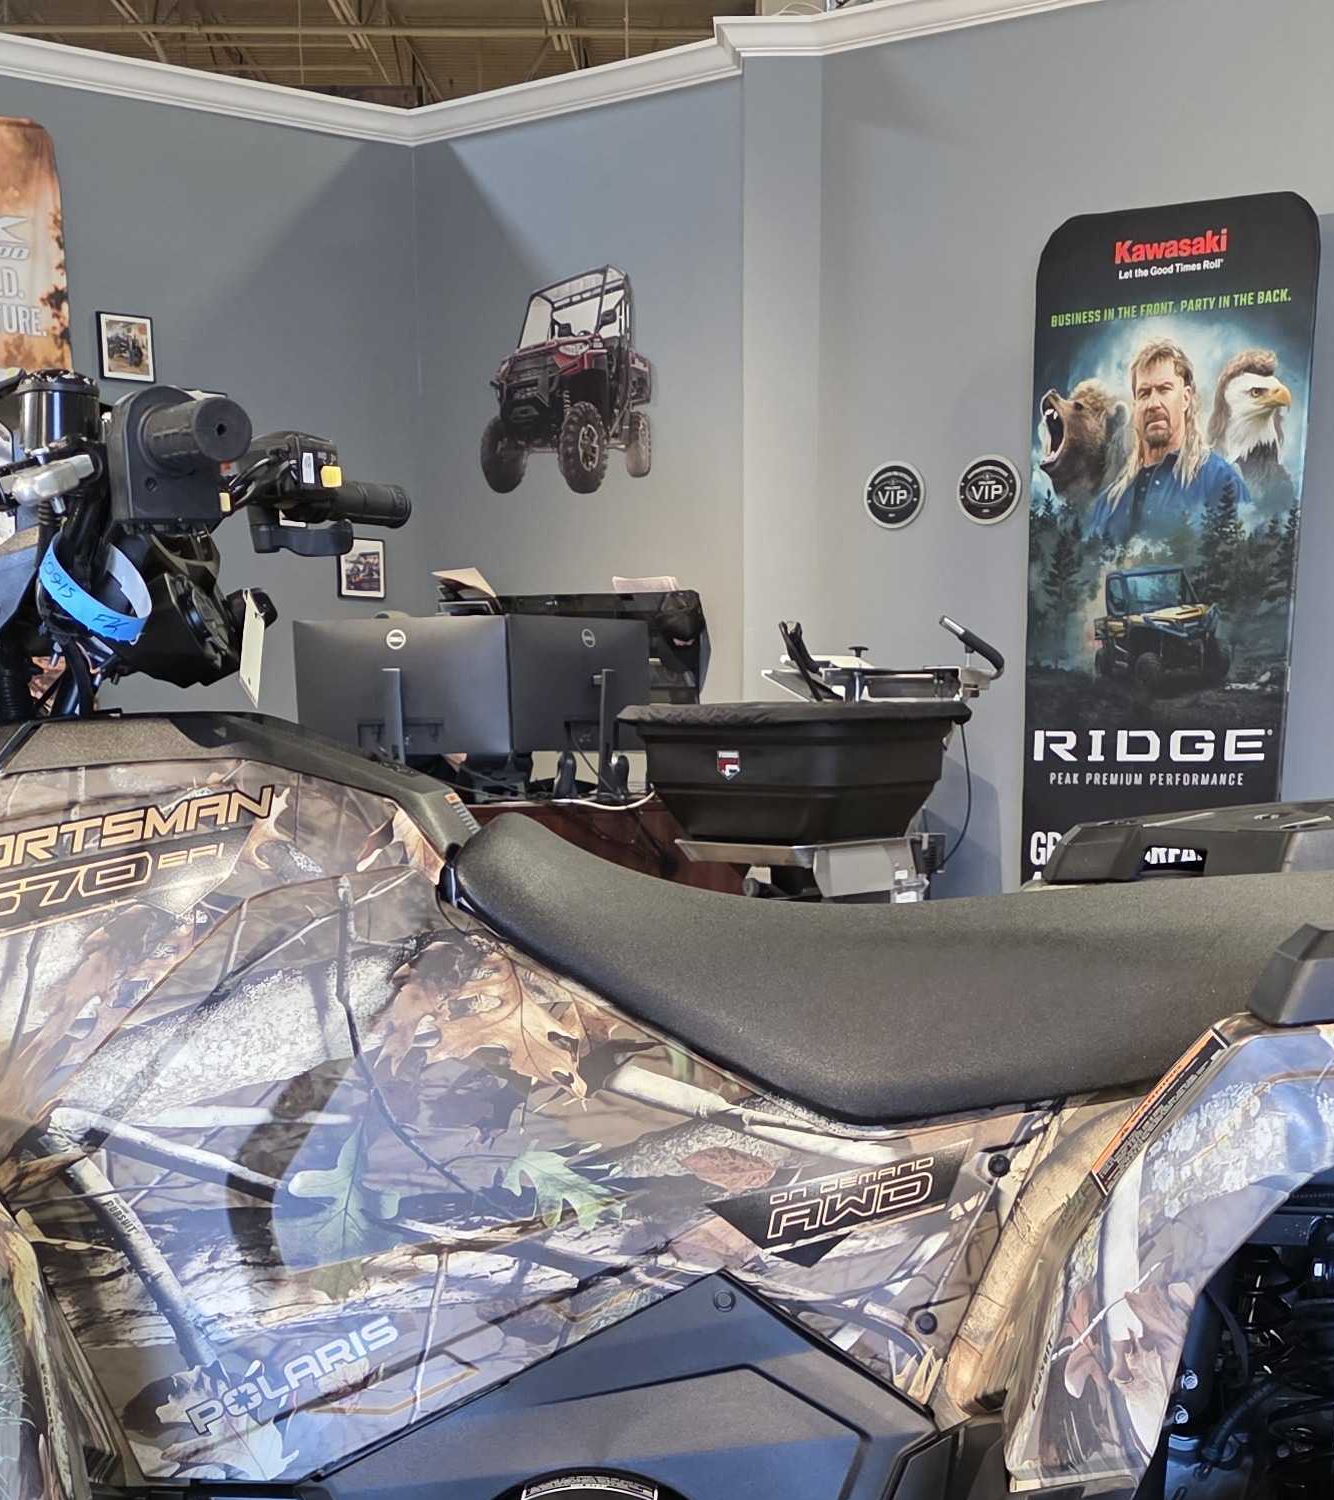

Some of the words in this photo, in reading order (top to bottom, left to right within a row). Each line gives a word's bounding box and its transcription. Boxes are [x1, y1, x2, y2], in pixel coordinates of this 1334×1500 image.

[1115, 228, 1228, 265] Kawasaki
[1118, 269, 1133, 280] Let
[1134, 267, 1149, 278] the
[1150, 264, 1174, 277] Good
[1175, 261, 1202, 274] Times
[1050, 310, 1101, 328] BUSINESS
[1103, 307, 1115, 320] IN
[1117, 304, 1138, 319] THE
[1139, 301, 1177, 317] FRONT.
[1180, 297, 1216, 312] PARTY
[1219, 296, 1231, 308] IN
[1233, 292, 1255, 306] THE
[1257, 287, 1292, 304] BACK.
[877, 489, 908, 505] VIP
[971, 484, 1003, 501] VIP
[1033, 728, 1266, 762] RIDGE
[1049, 771, 1080, 786] PEAK
[1085, 771, 1144, 786] PREMIUM
[1149, 771, 1245, 786] PERFORMANCE
[157, 842, 227, 870] EFI
[769, 1186, 807, 1205] ON
[820, 1156, 935, 1194] DEMAND
[103, 1199, 138, 1235] PURSUIT
[767, 1171, 933, 1240] AWD
[185, 1315, 399, 1436] POLARIS
